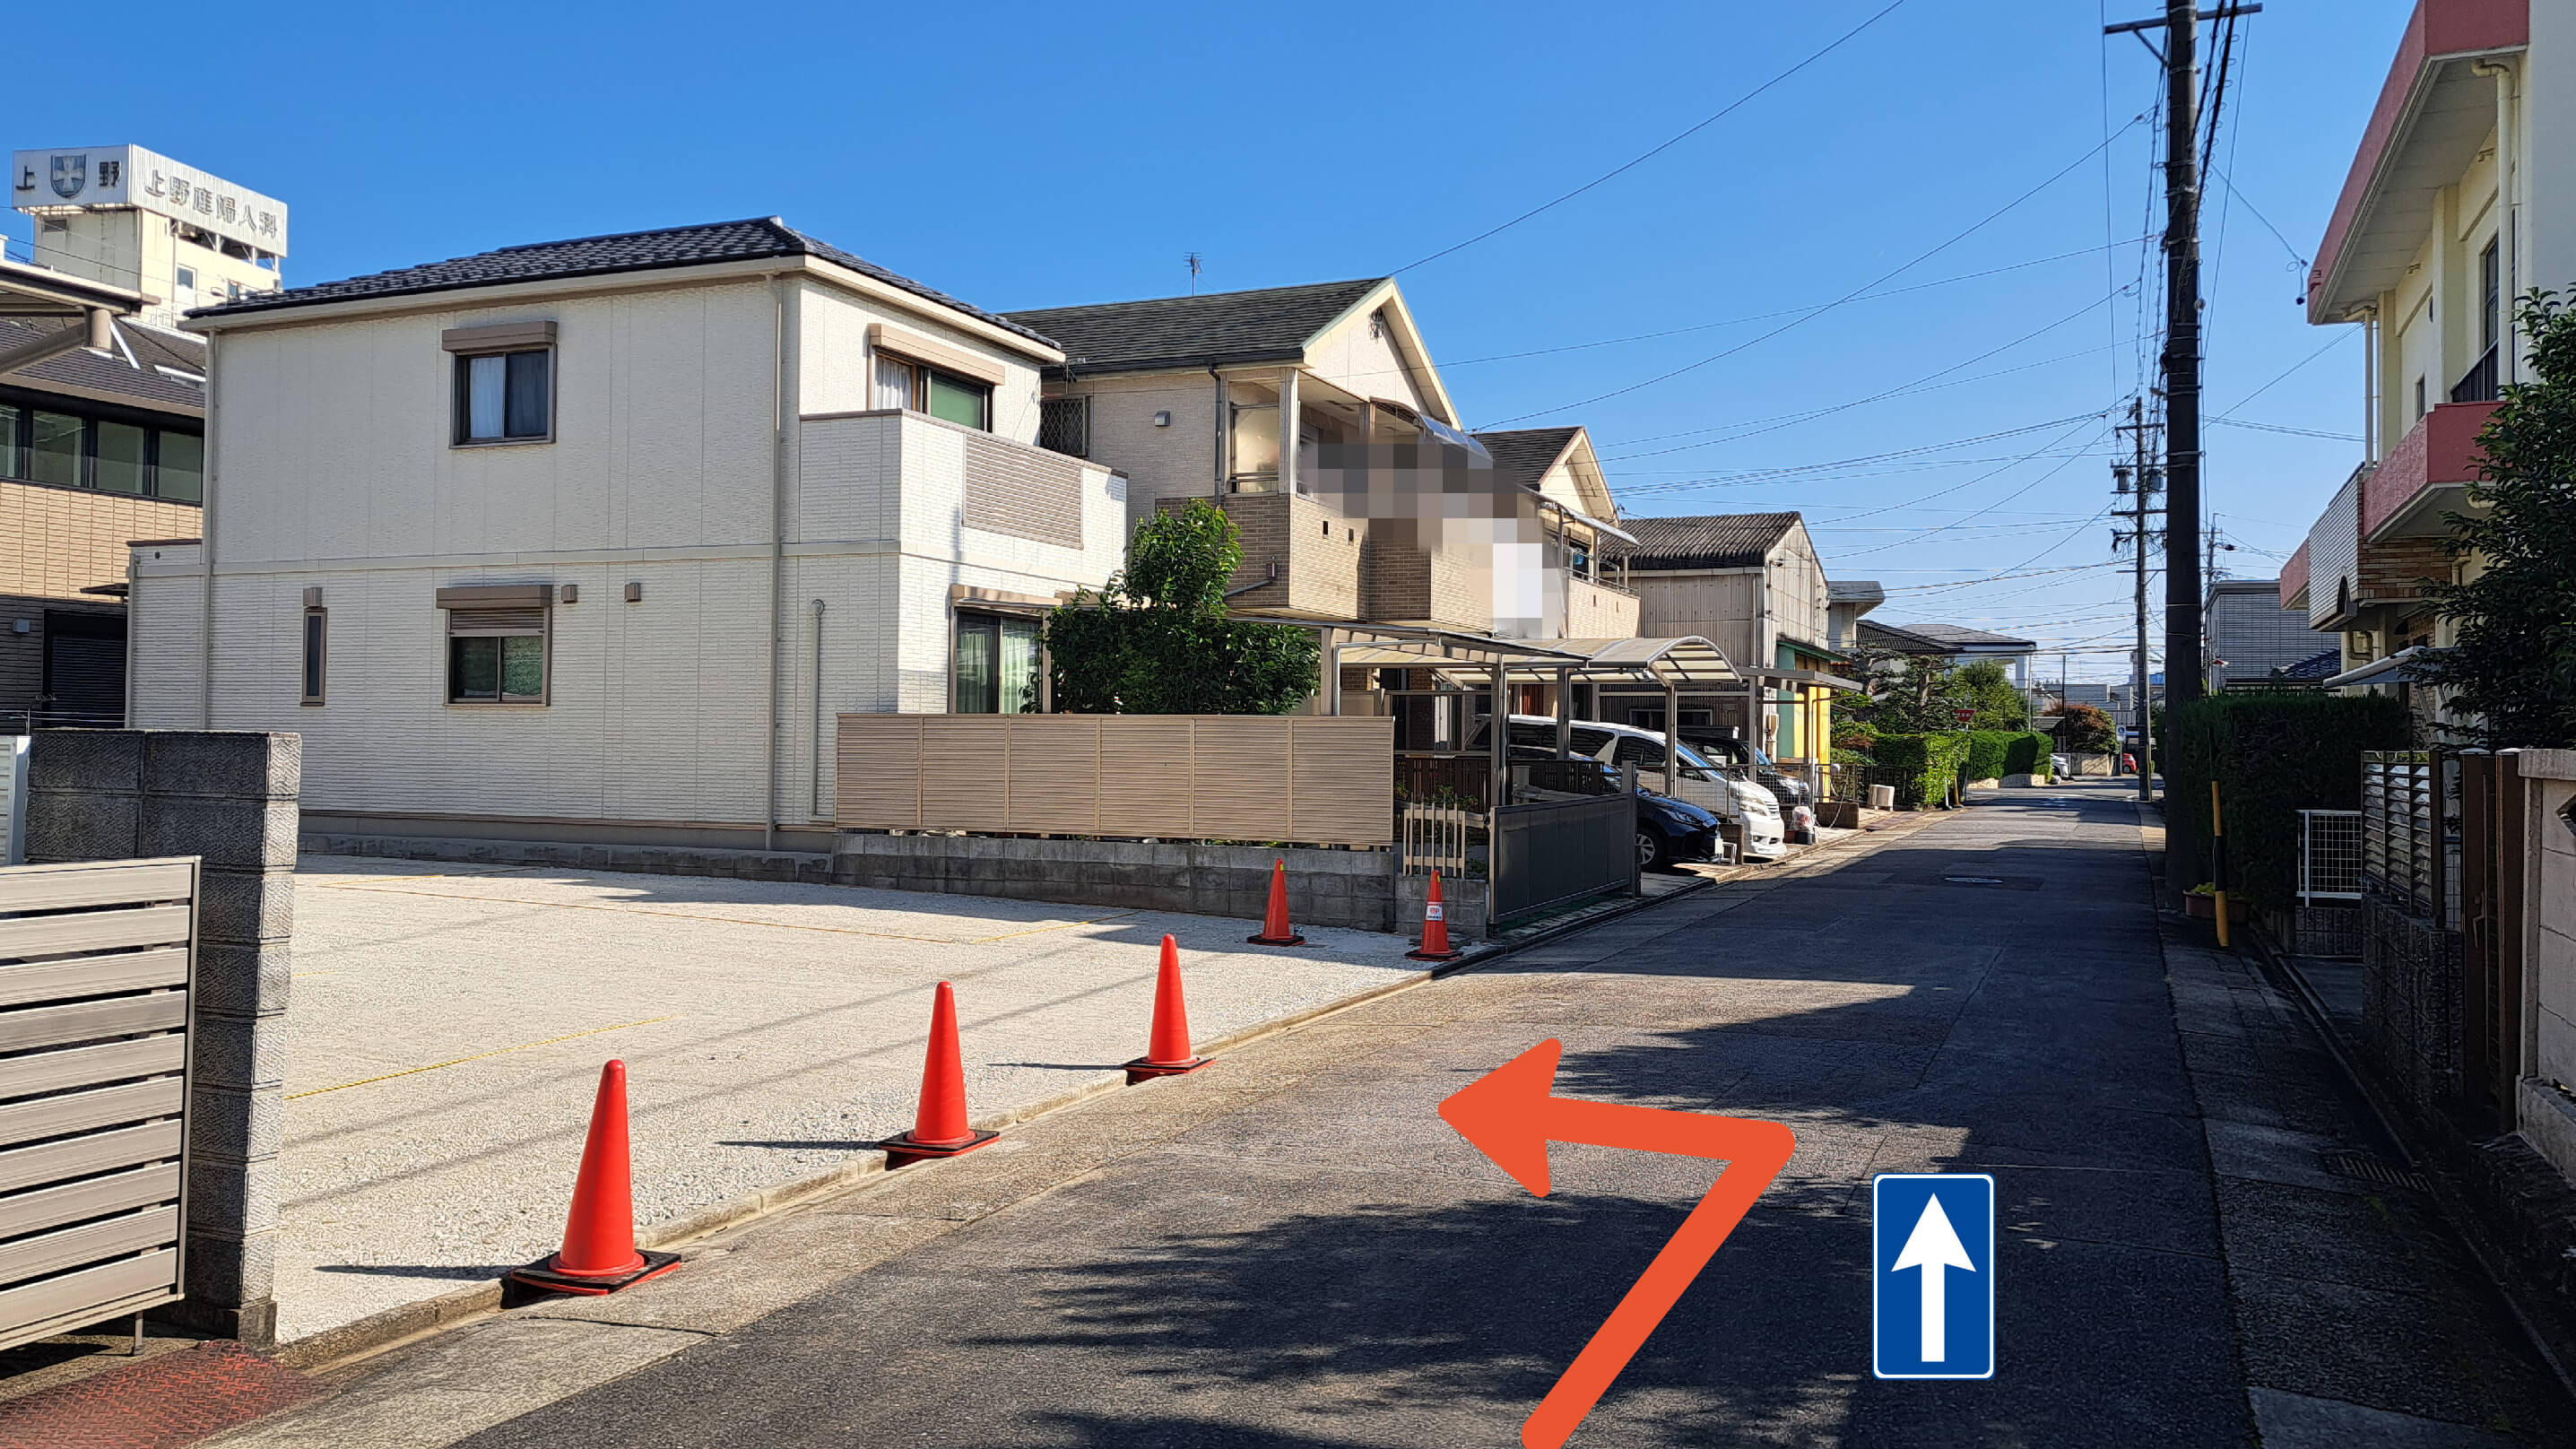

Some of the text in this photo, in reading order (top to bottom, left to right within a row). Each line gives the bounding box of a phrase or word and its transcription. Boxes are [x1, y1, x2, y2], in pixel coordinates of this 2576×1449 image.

[15, 161, 121, 190] 上 野
[144, 169, 277, 239] 上野産婦人科
